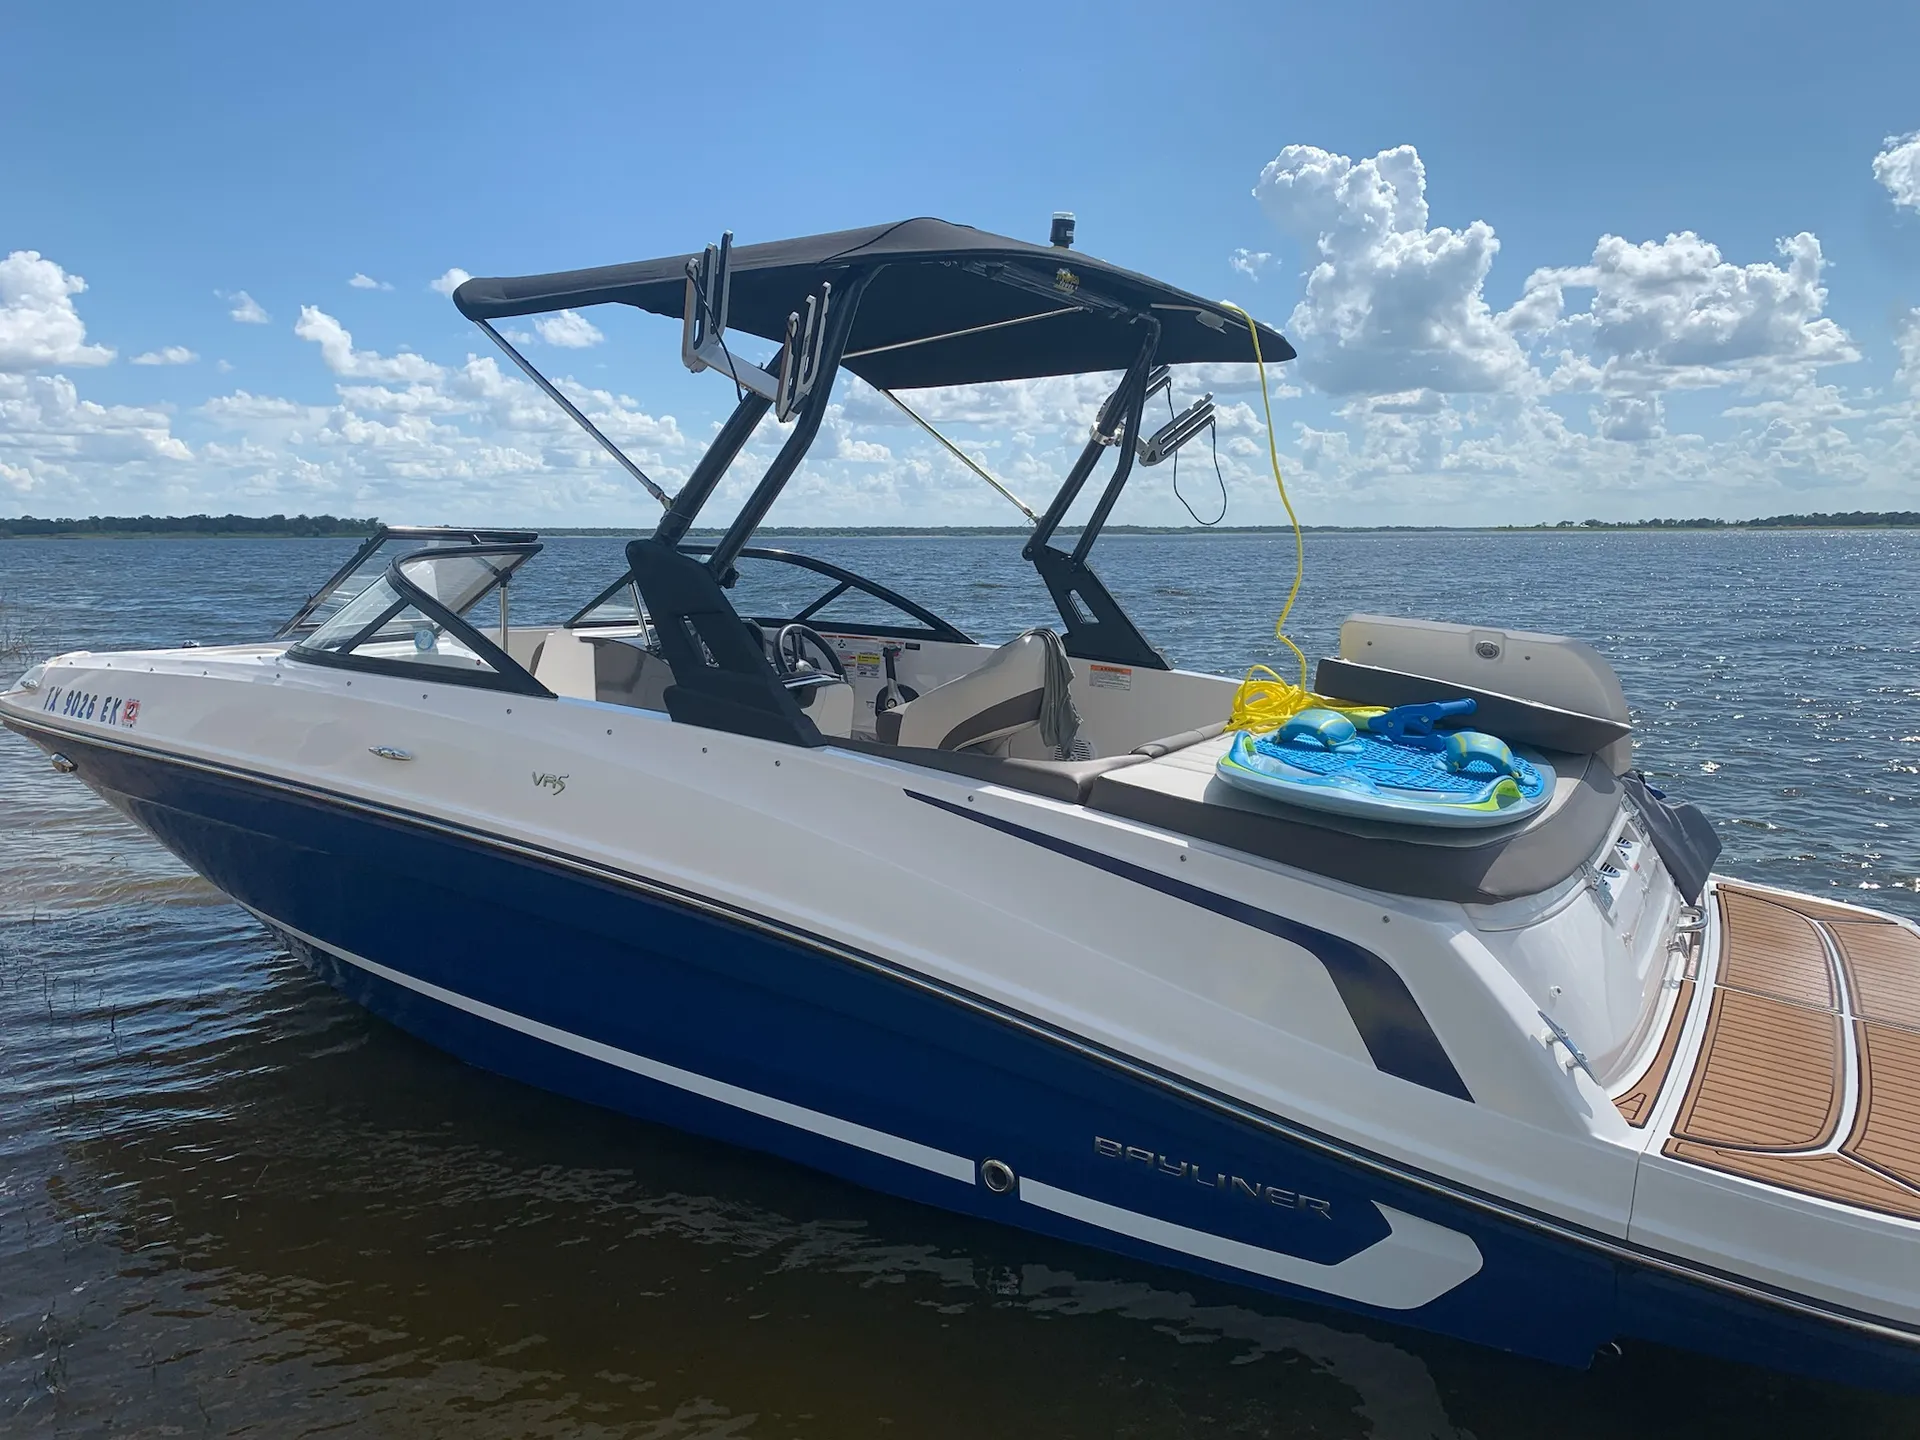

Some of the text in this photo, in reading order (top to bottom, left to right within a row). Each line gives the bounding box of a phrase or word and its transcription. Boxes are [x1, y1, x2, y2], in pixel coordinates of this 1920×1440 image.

[43, 686, 122, 725] TX 9026 EK
[1094, 1136, 1333, 1220] BAYLINER
